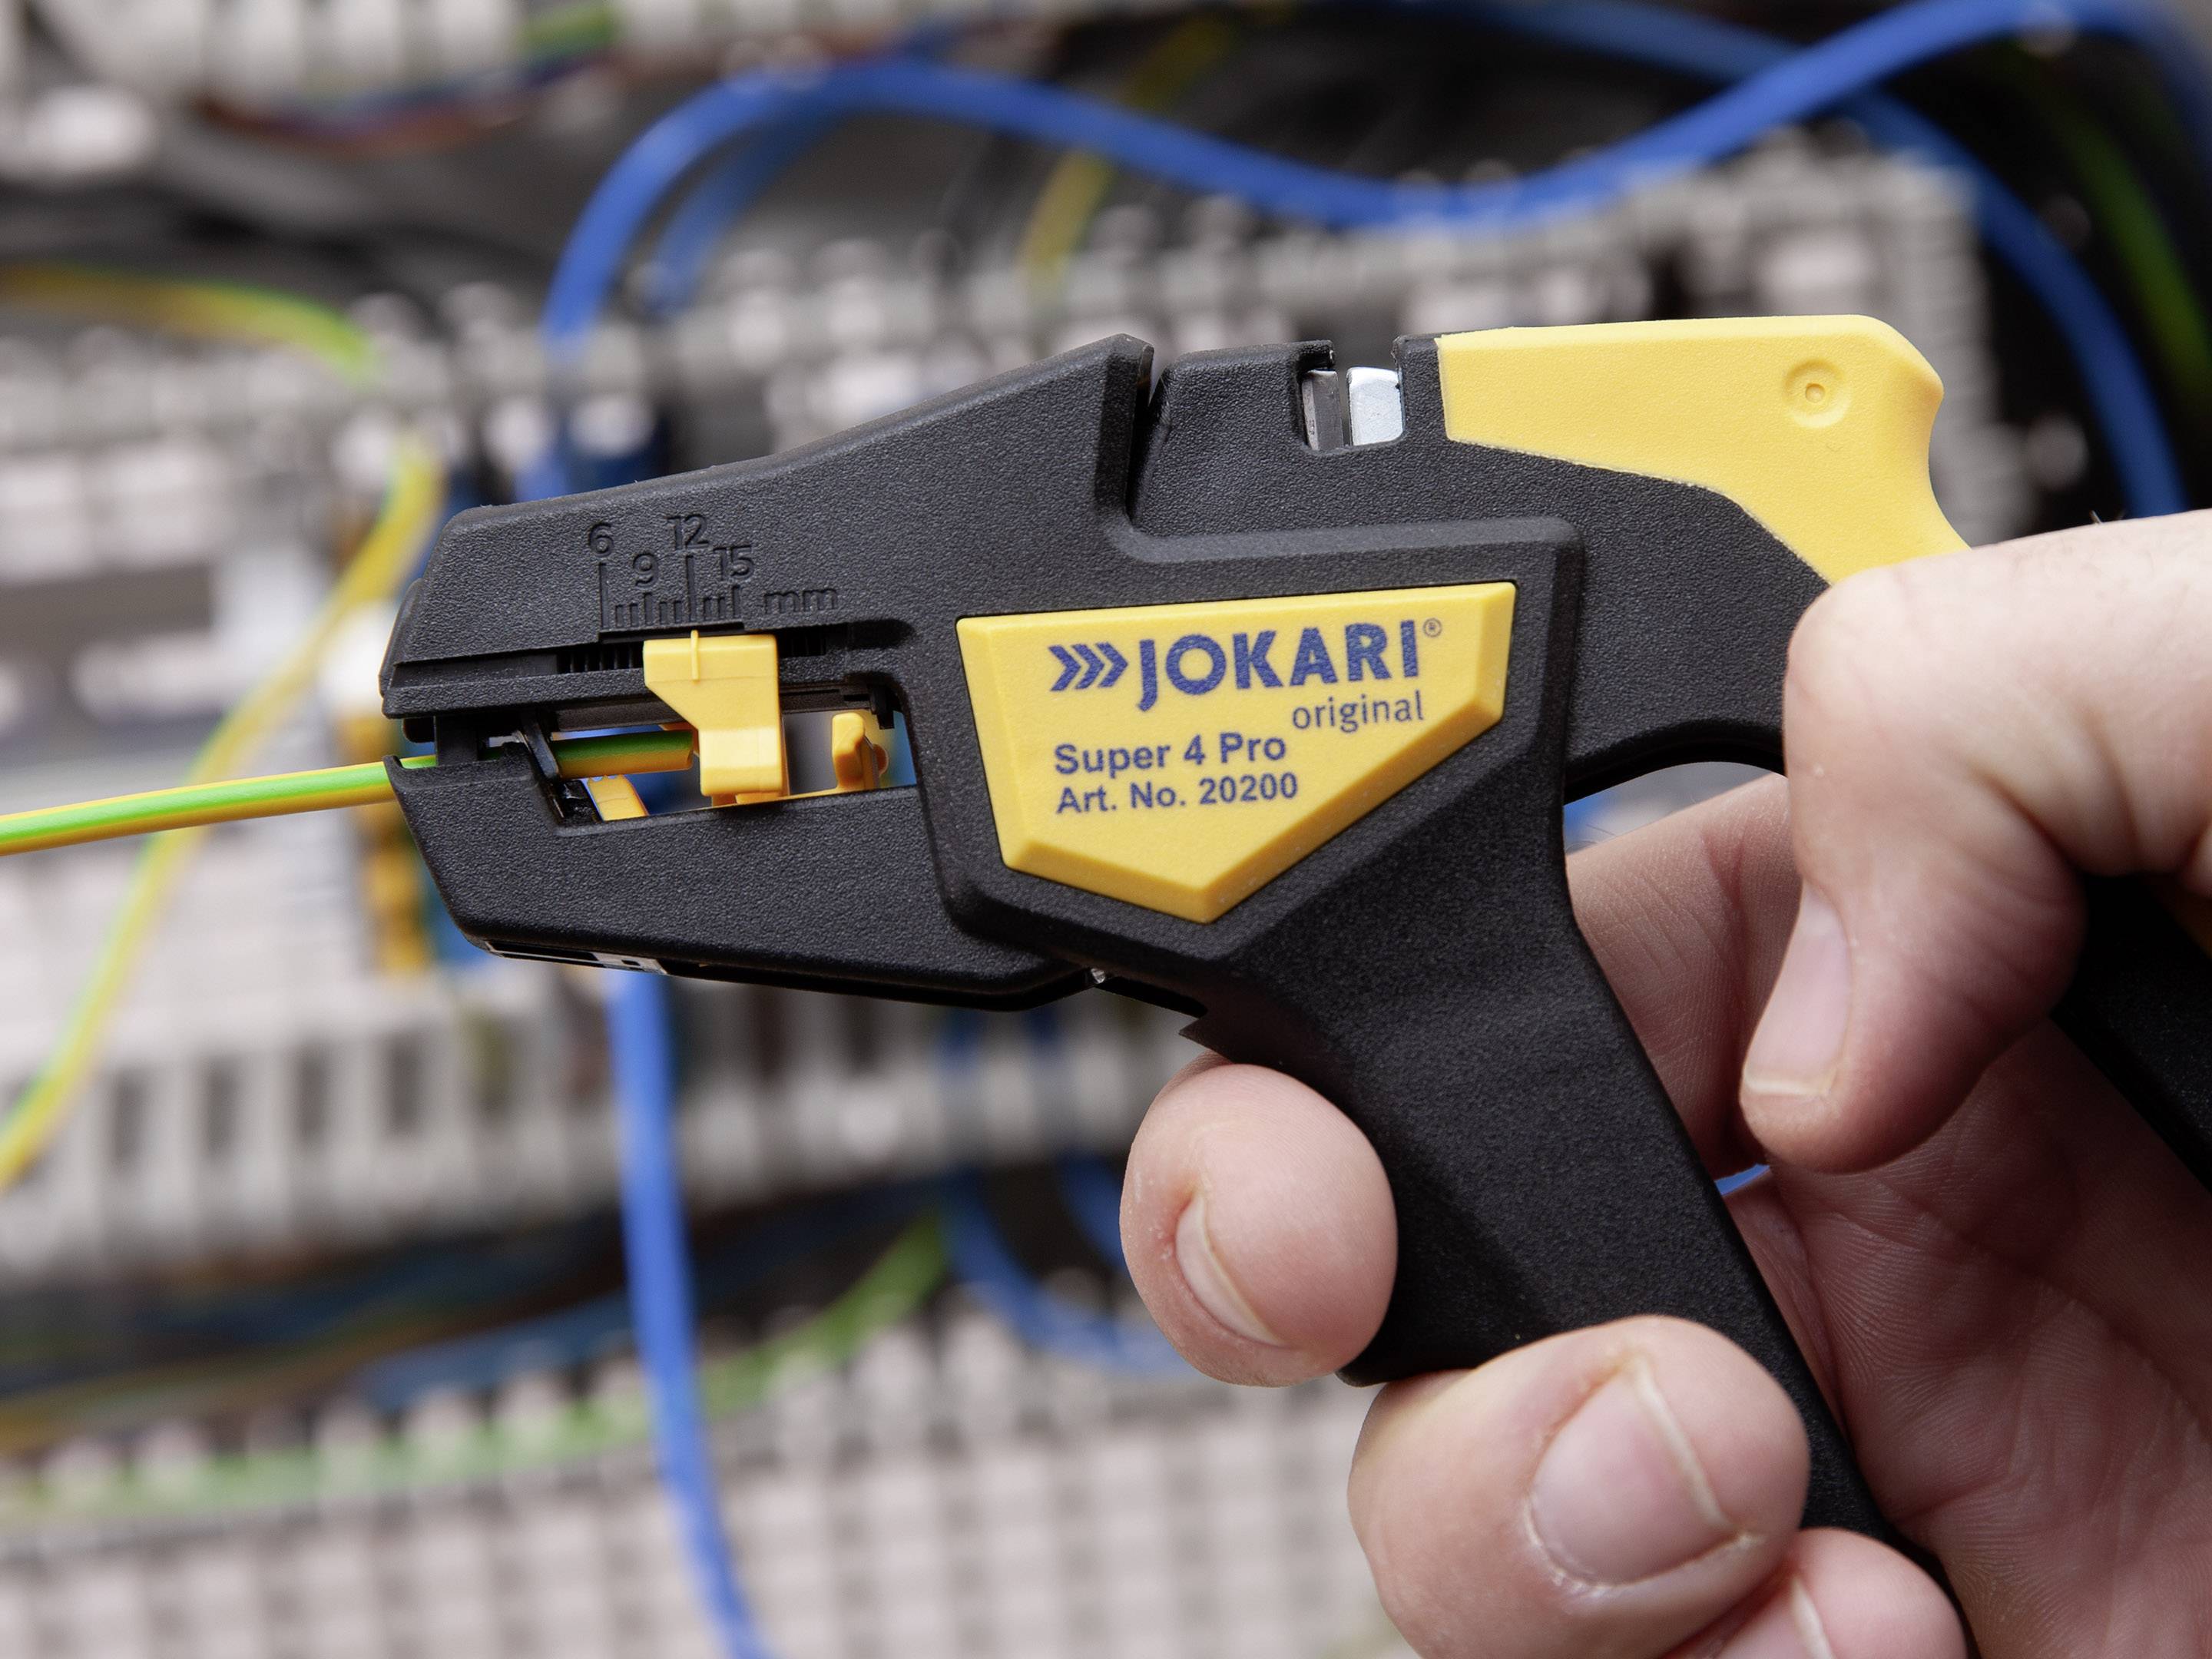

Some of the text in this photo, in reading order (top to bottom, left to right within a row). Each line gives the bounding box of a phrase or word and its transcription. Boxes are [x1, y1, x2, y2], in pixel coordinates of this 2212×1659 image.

[587, 521, 614, 558] 6
[662, 513, 711, 551] 12
[631, 550, 659, 588] 9
[712, 543, 756, 581] 15
[763, 587, 839, 615] mm
[1292, 690, 1424, 733] original
[1054, 731, 1286, 778] Super 4 Pro
[1055, 772, 1298, 814] Art. No. 20200
